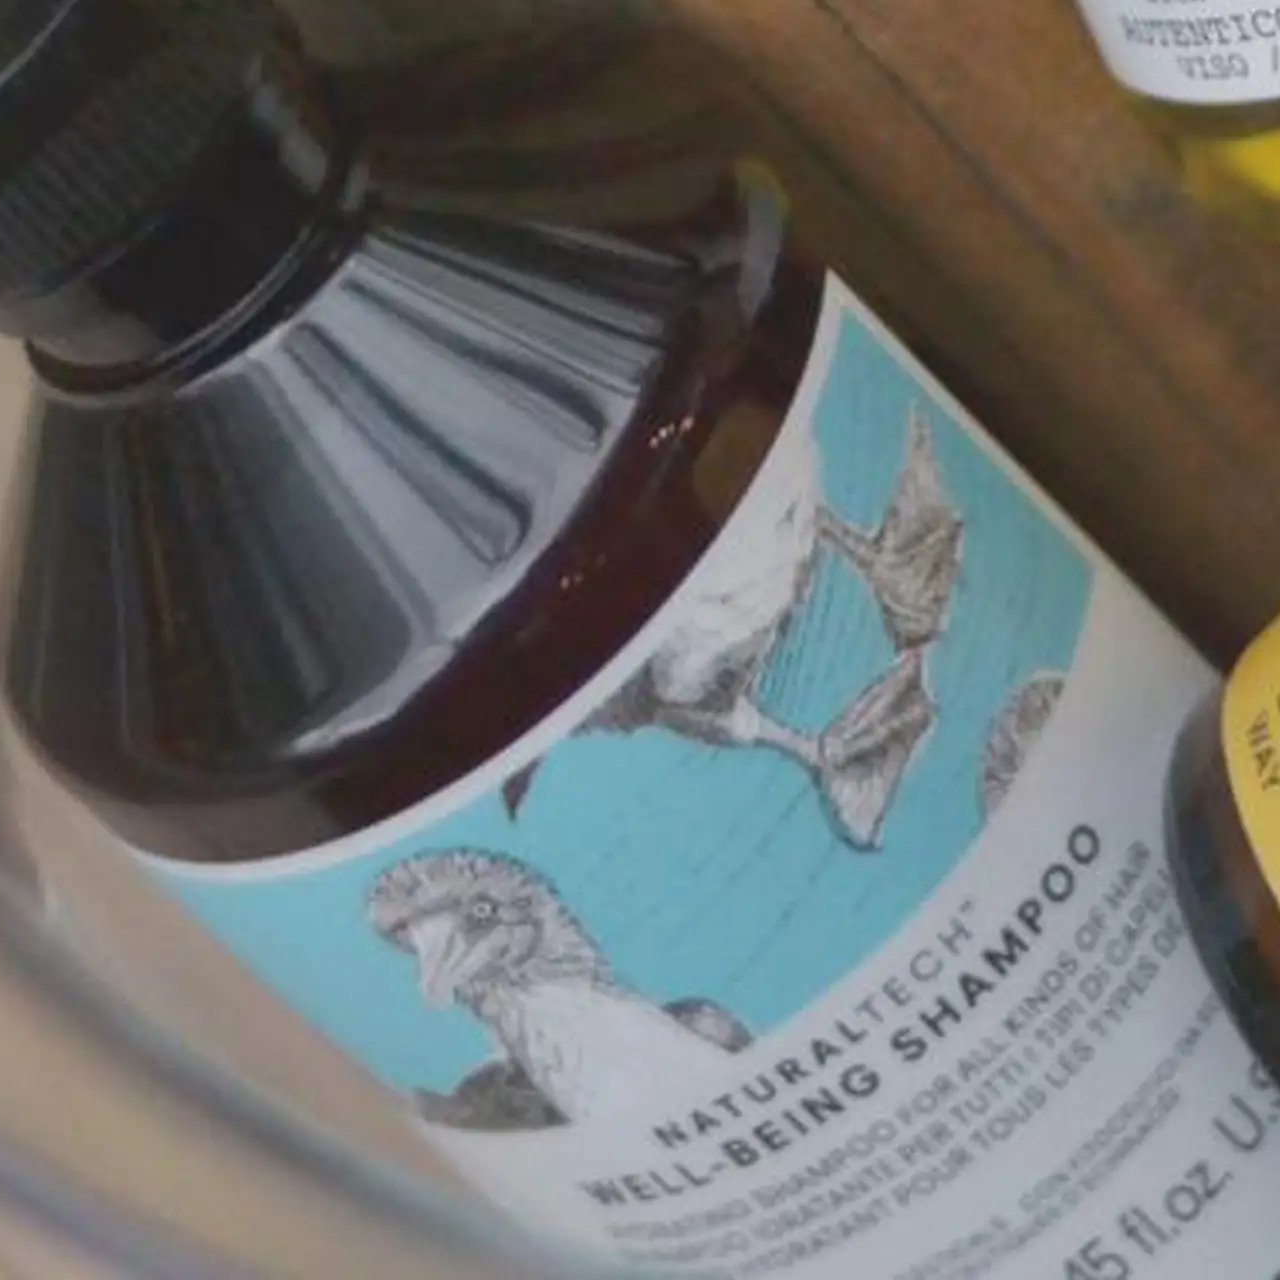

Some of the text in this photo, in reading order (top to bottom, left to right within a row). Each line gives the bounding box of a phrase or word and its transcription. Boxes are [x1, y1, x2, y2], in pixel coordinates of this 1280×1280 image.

[1177, 54, 1250, 81] VISO
[583, 1061, 883, 1207] WELL-BEING
[889, 820, 1106, 1064] SHAMPOO
[953, 1029, 1010, 1083] ALL
[1001, 951, 1080, 1035] KINDS
[1073, 908, 1110, 954] OF
[969, 1083, 1050, 1155] TOUS
[1115, 1159, 1235, 1256] fl.oz.
